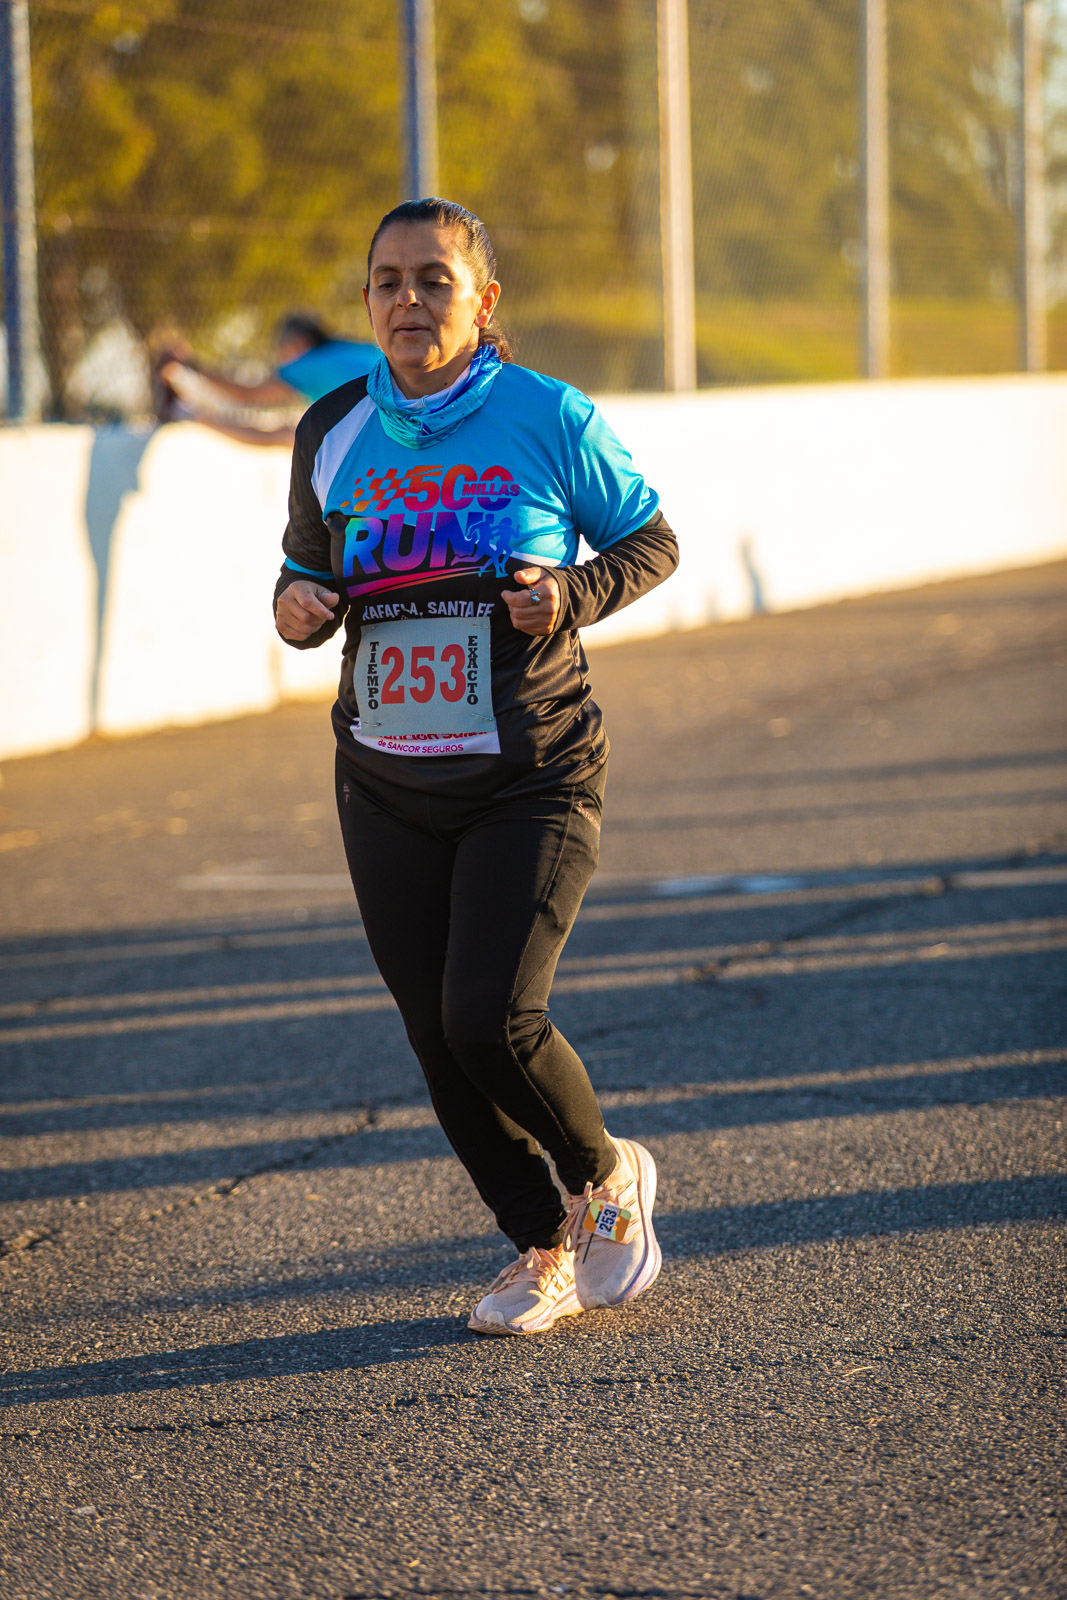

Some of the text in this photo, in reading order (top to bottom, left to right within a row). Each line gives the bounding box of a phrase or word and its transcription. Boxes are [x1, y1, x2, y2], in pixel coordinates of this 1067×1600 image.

[403, 464, 520, 512] 500 MILLAS
[343, 511, 484, 578] RUN
[427, 600, 475, 618] SANTA
[367, 641, 379, 710] TIEMPO
[380, 644, 467, 705] 253
[466, 635, 479, 706] EXACTO
[377, 739, 464, 753] de SANCOR SEGUROS
[599, 1209, 617, 1232] 253
